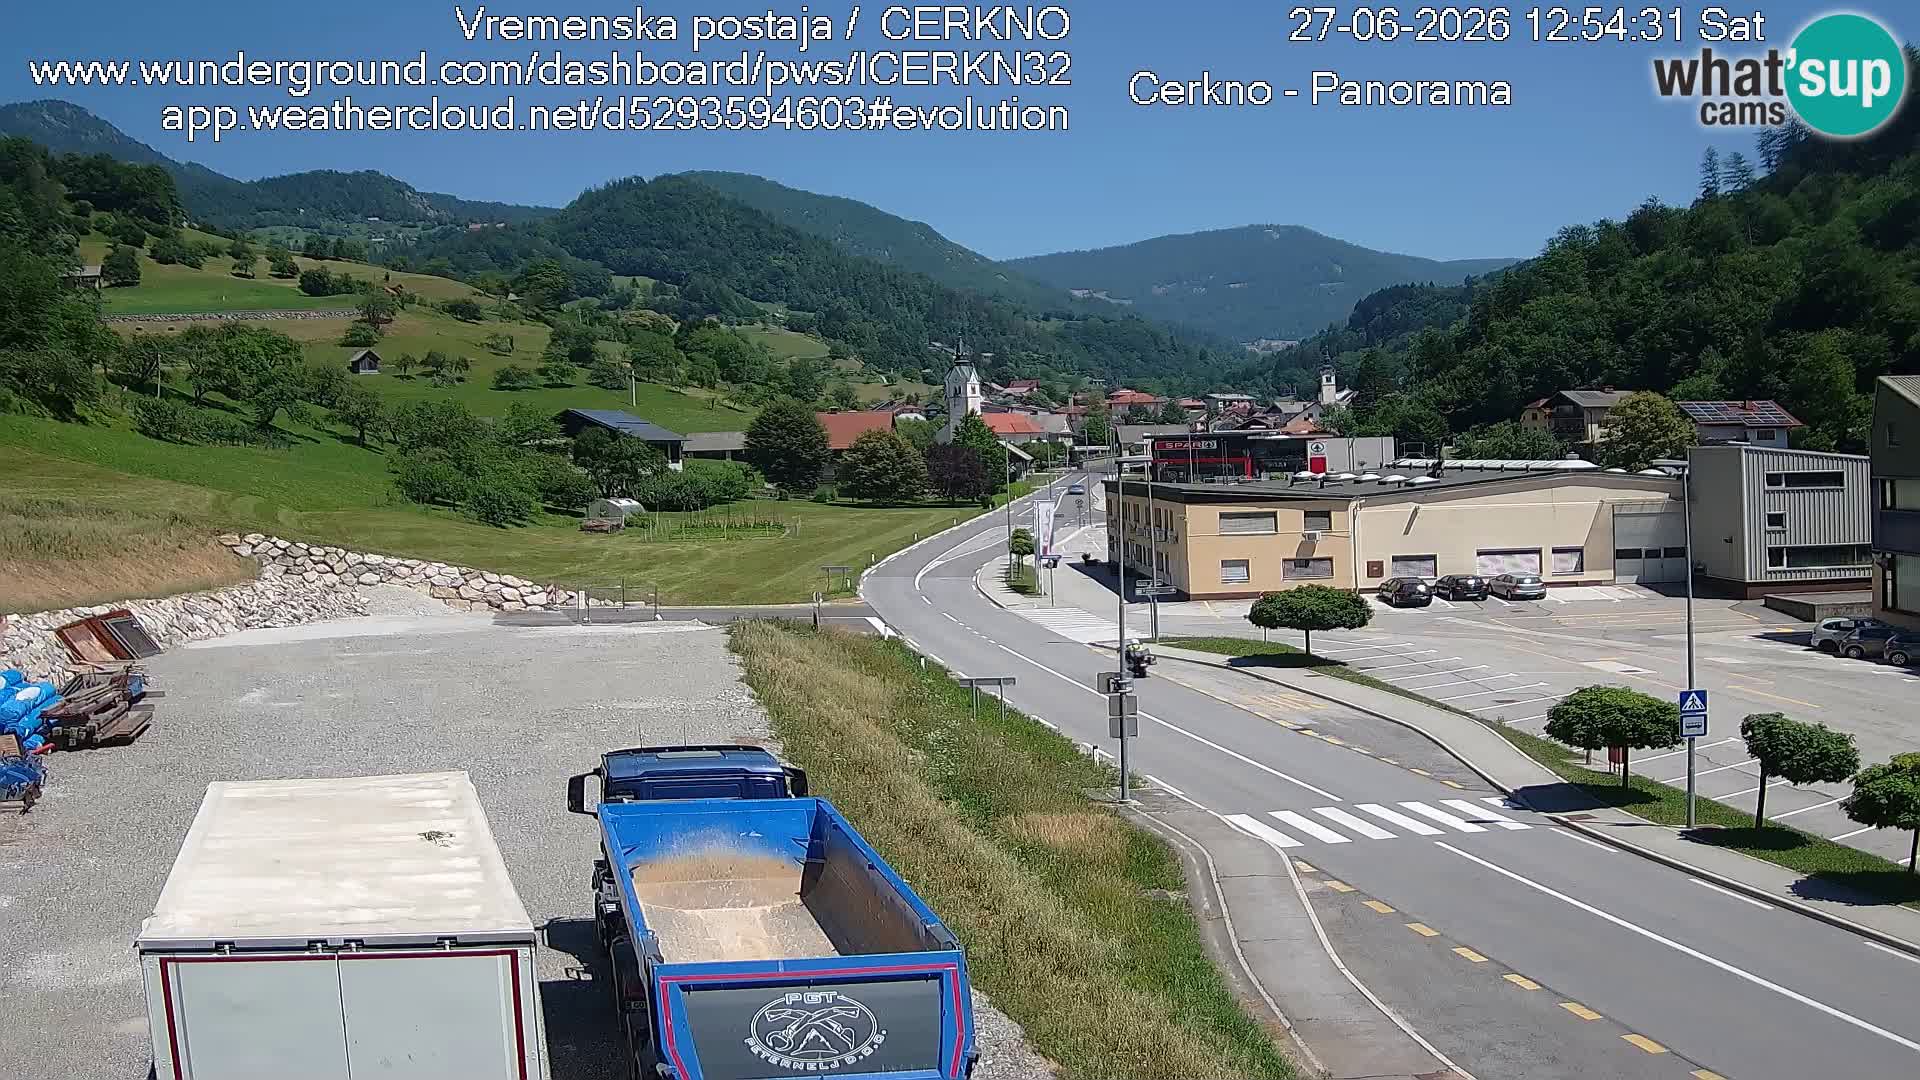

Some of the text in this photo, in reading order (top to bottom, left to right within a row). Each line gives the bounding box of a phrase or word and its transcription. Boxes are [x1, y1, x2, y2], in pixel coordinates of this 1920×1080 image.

[1165, 441, 1202, 449] SPAR
[784, 990, 838, 1005] PGT
[743, 1036, 840, 1072] PETERNELJ
